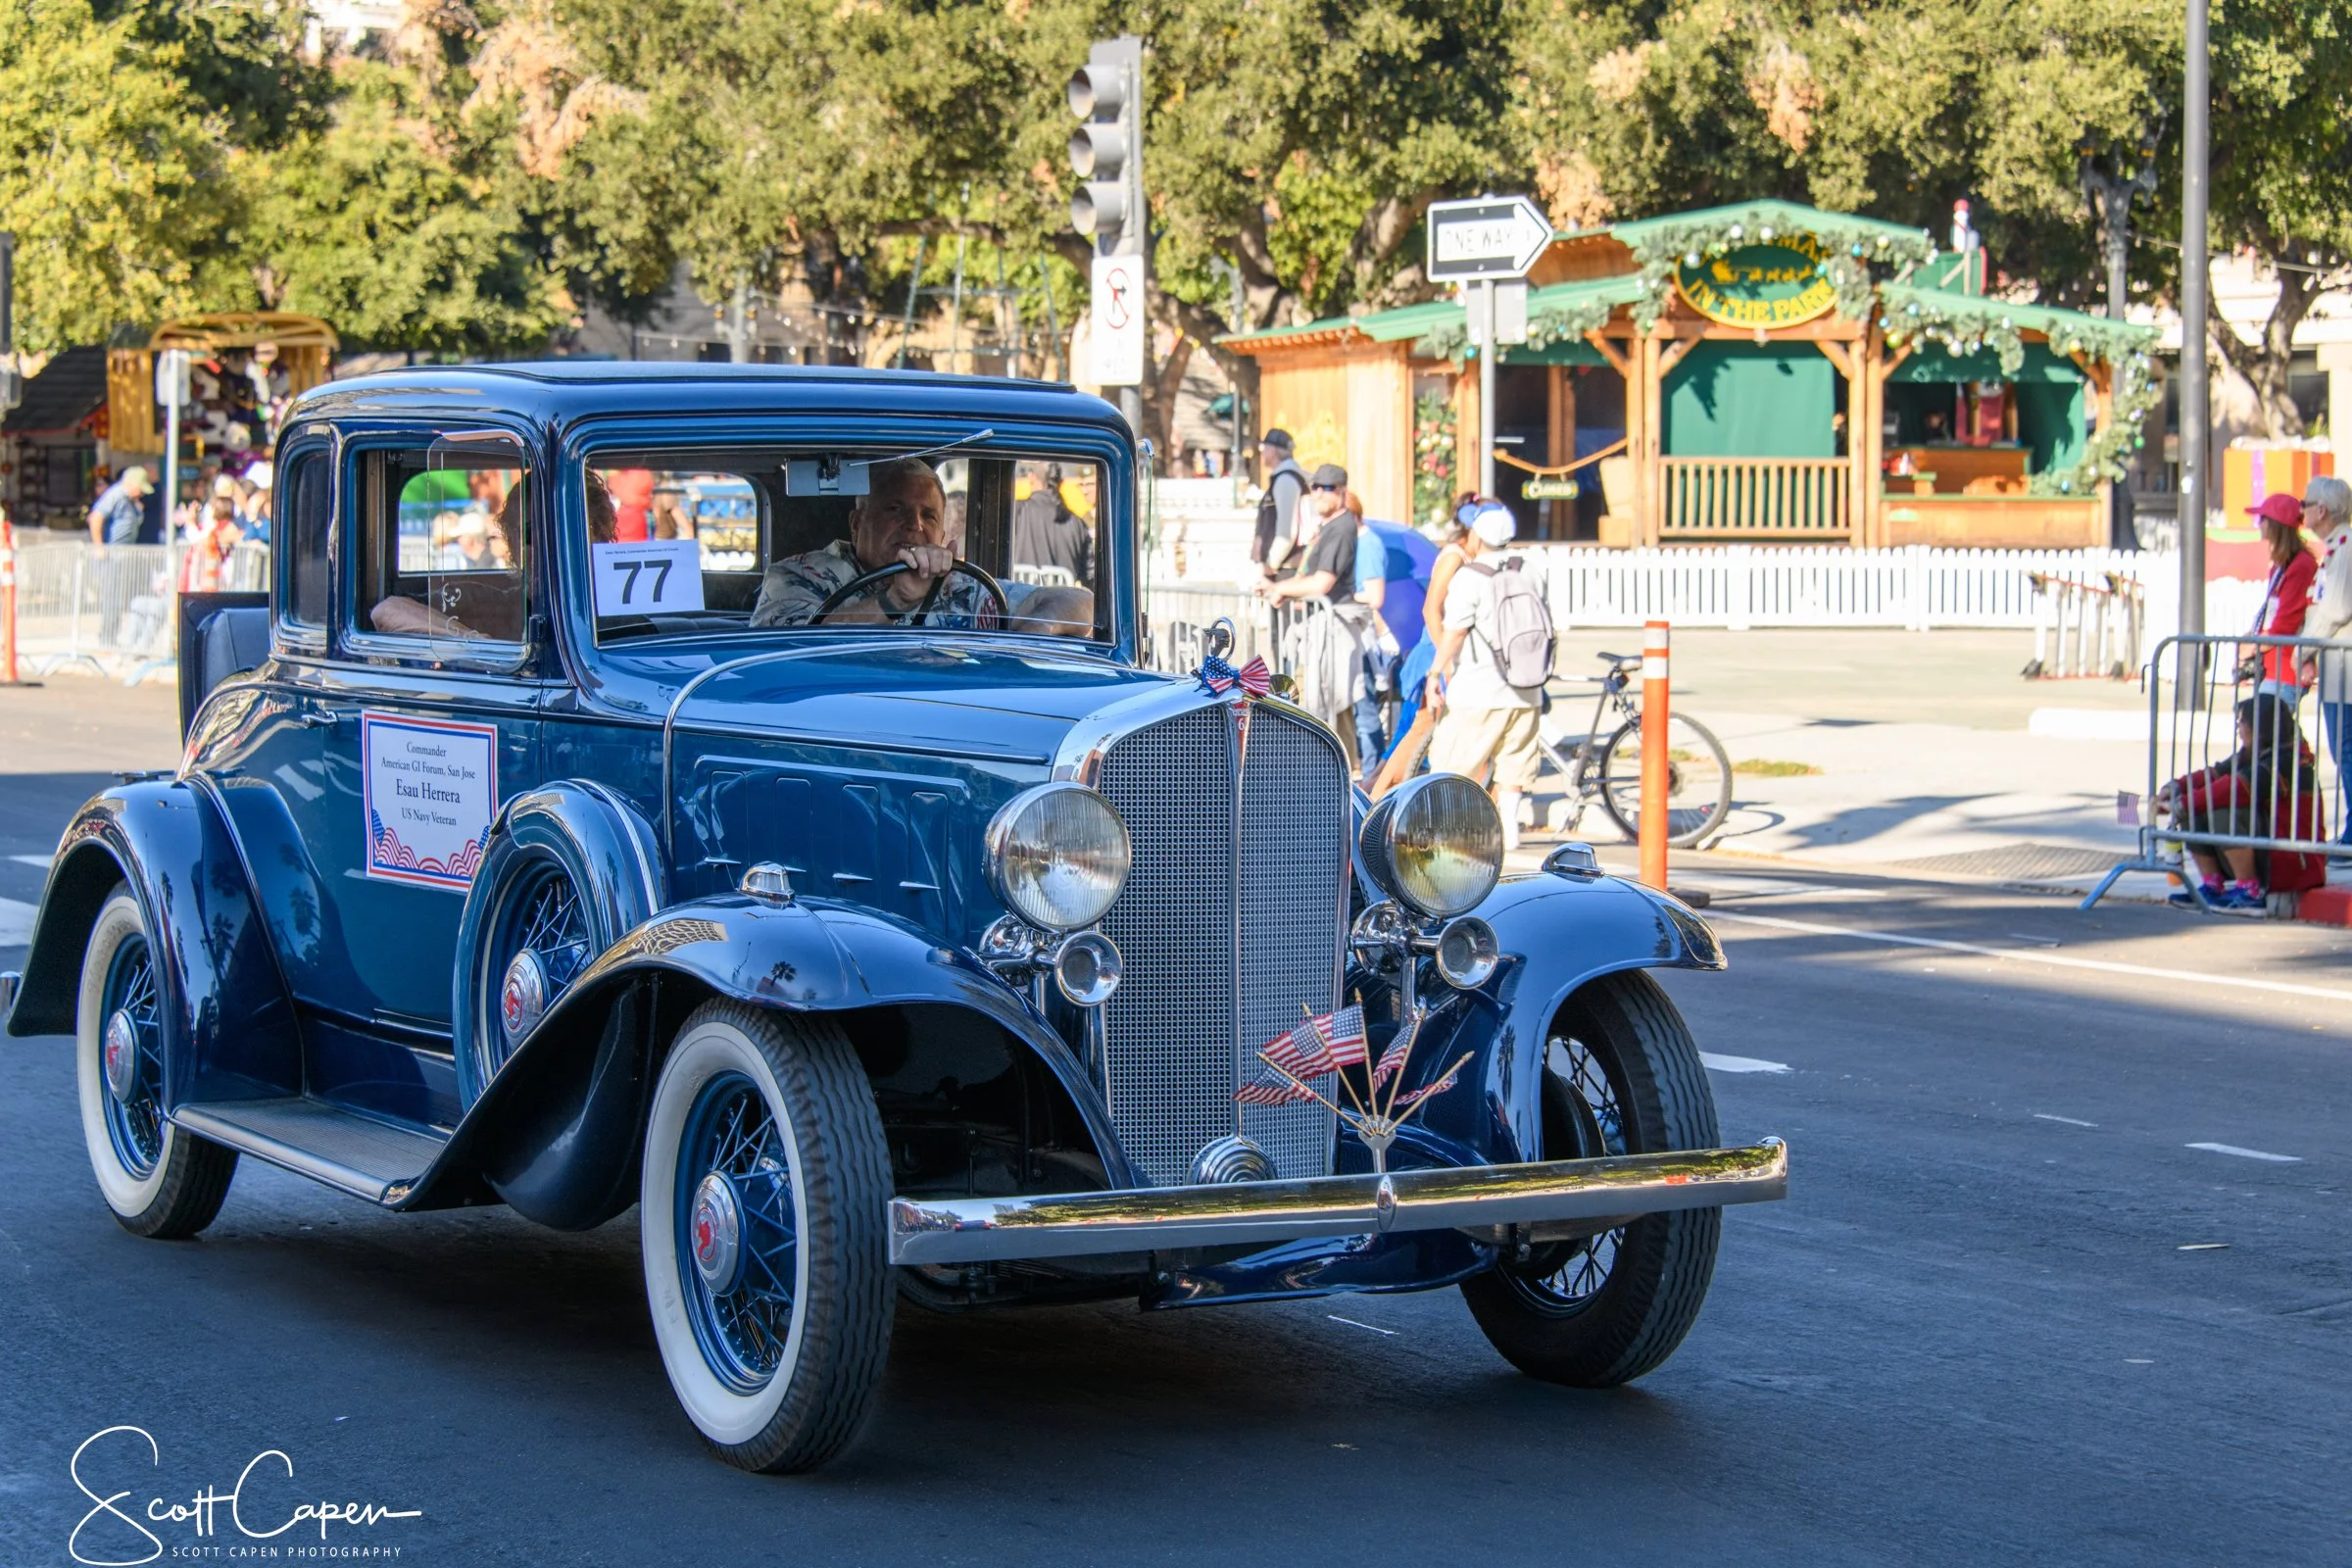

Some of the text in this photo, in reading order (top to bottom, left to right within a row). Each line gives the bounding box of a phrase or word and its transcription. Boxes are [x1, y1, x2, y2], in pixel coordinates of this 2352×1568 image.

[1443, 226, 1514, 254] ONE WAY
[1687, 277, 1835, 321] IN THE PARK
[612, 559, 673, 605] 77
[406, 741, 447, 758] Commander
[380, 757, 411, 772] American
[412, 760, 420, 773] GI
[447, 764, 461, 777] San
[461, 766, 476, 780] Jose
[396, 778, 461, 804] Esau Herrera
[401, 808, 457, 826] US Navy Veteran
